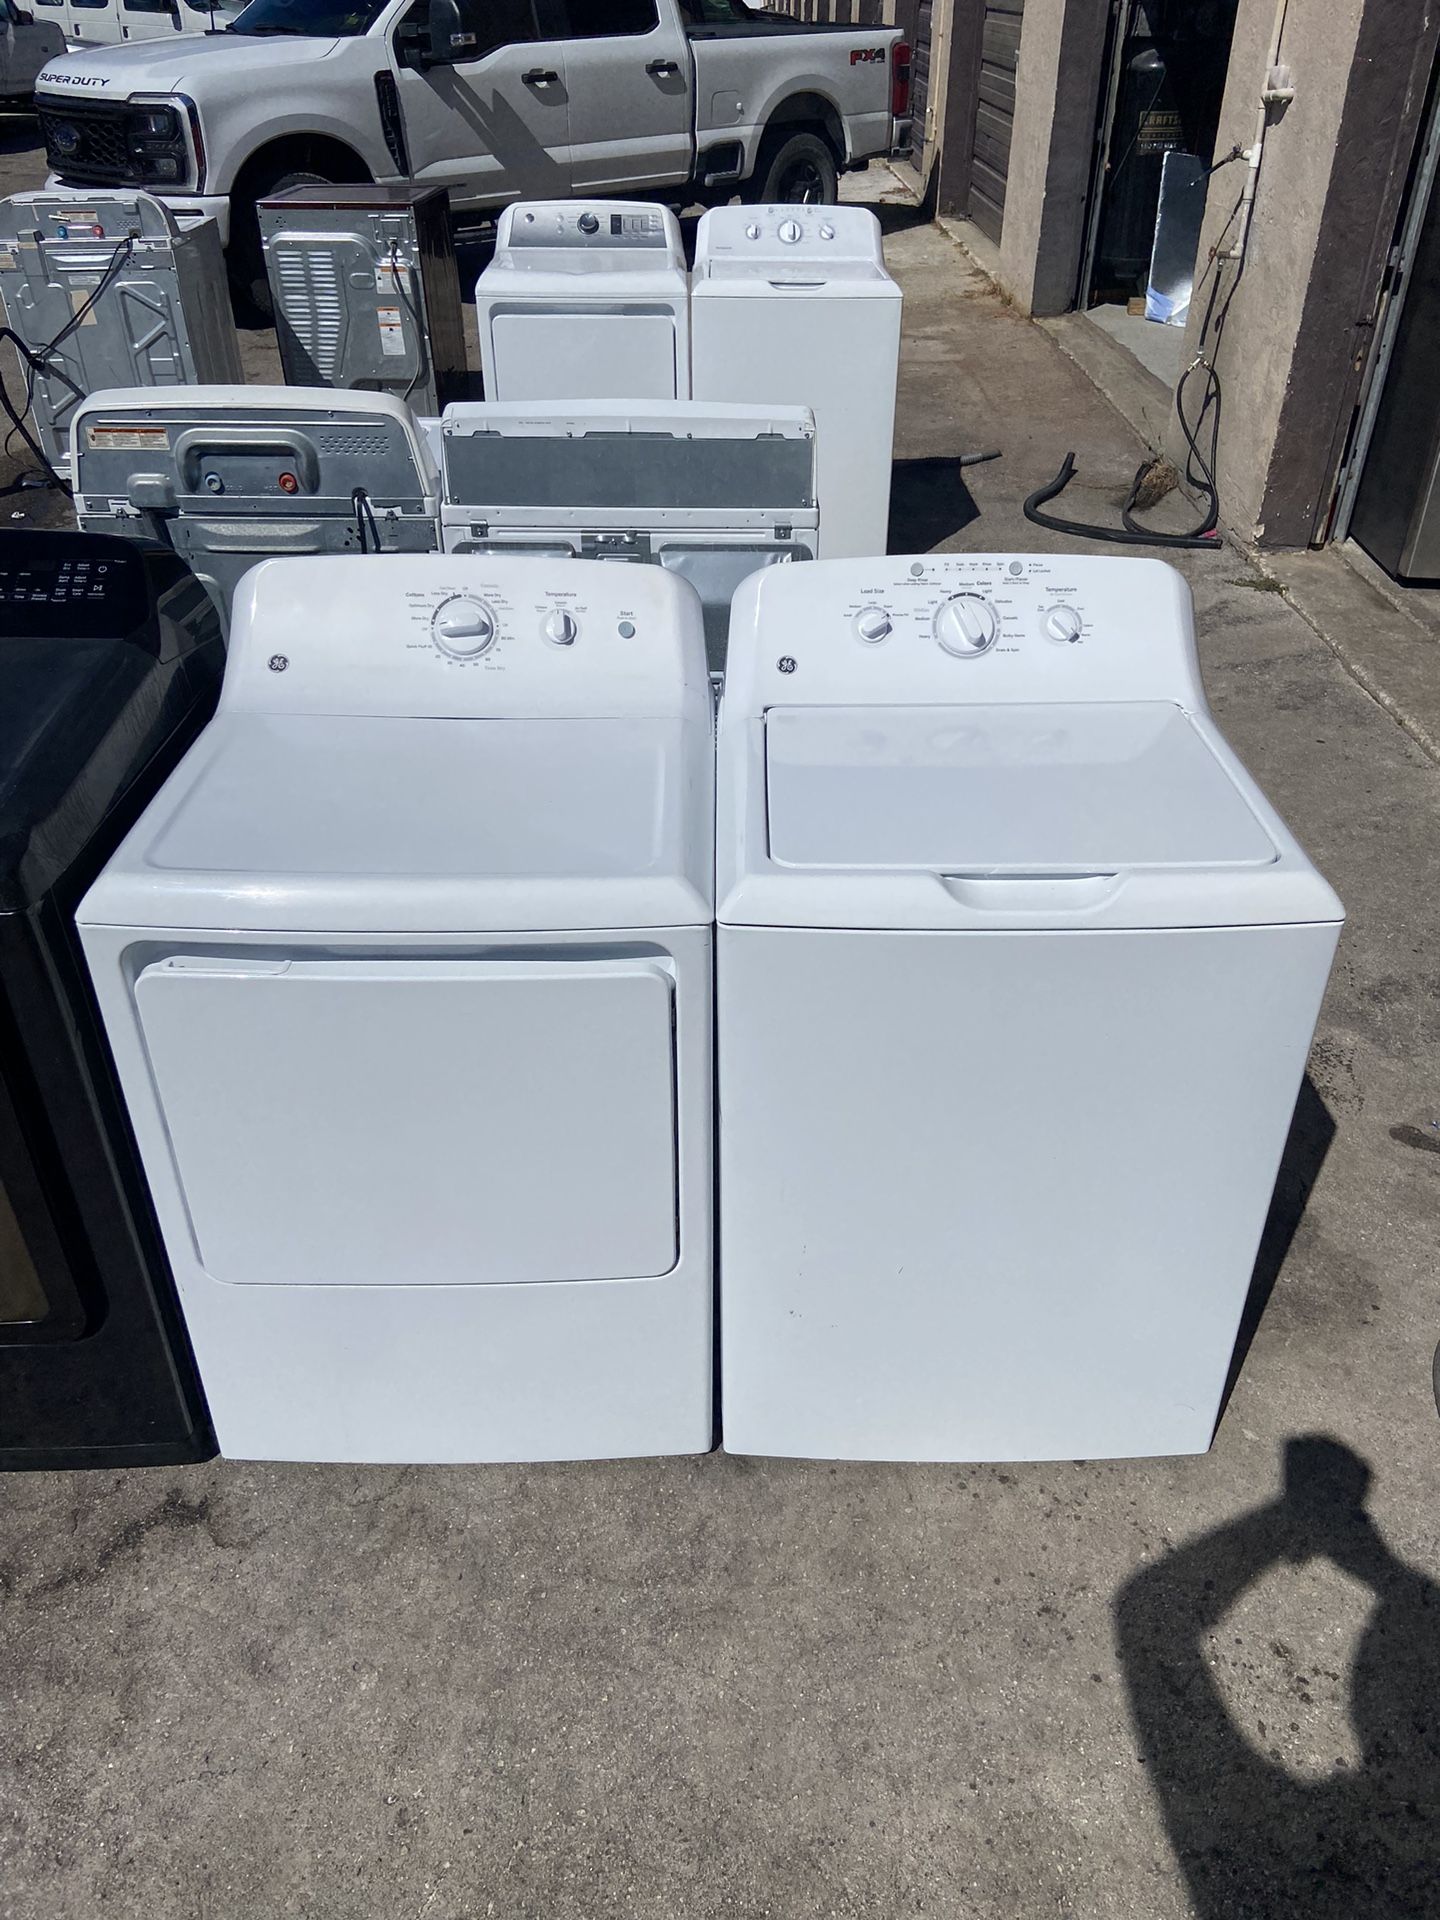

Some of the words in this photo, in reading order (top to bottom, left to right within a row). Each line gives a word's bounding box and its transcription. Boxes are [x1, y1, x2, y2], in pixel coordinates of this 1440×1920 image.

[850, 48, 885, 65] FX4
[39, 72, 71, 84] SUPER
[71, 76, 111, 86] DUTY
